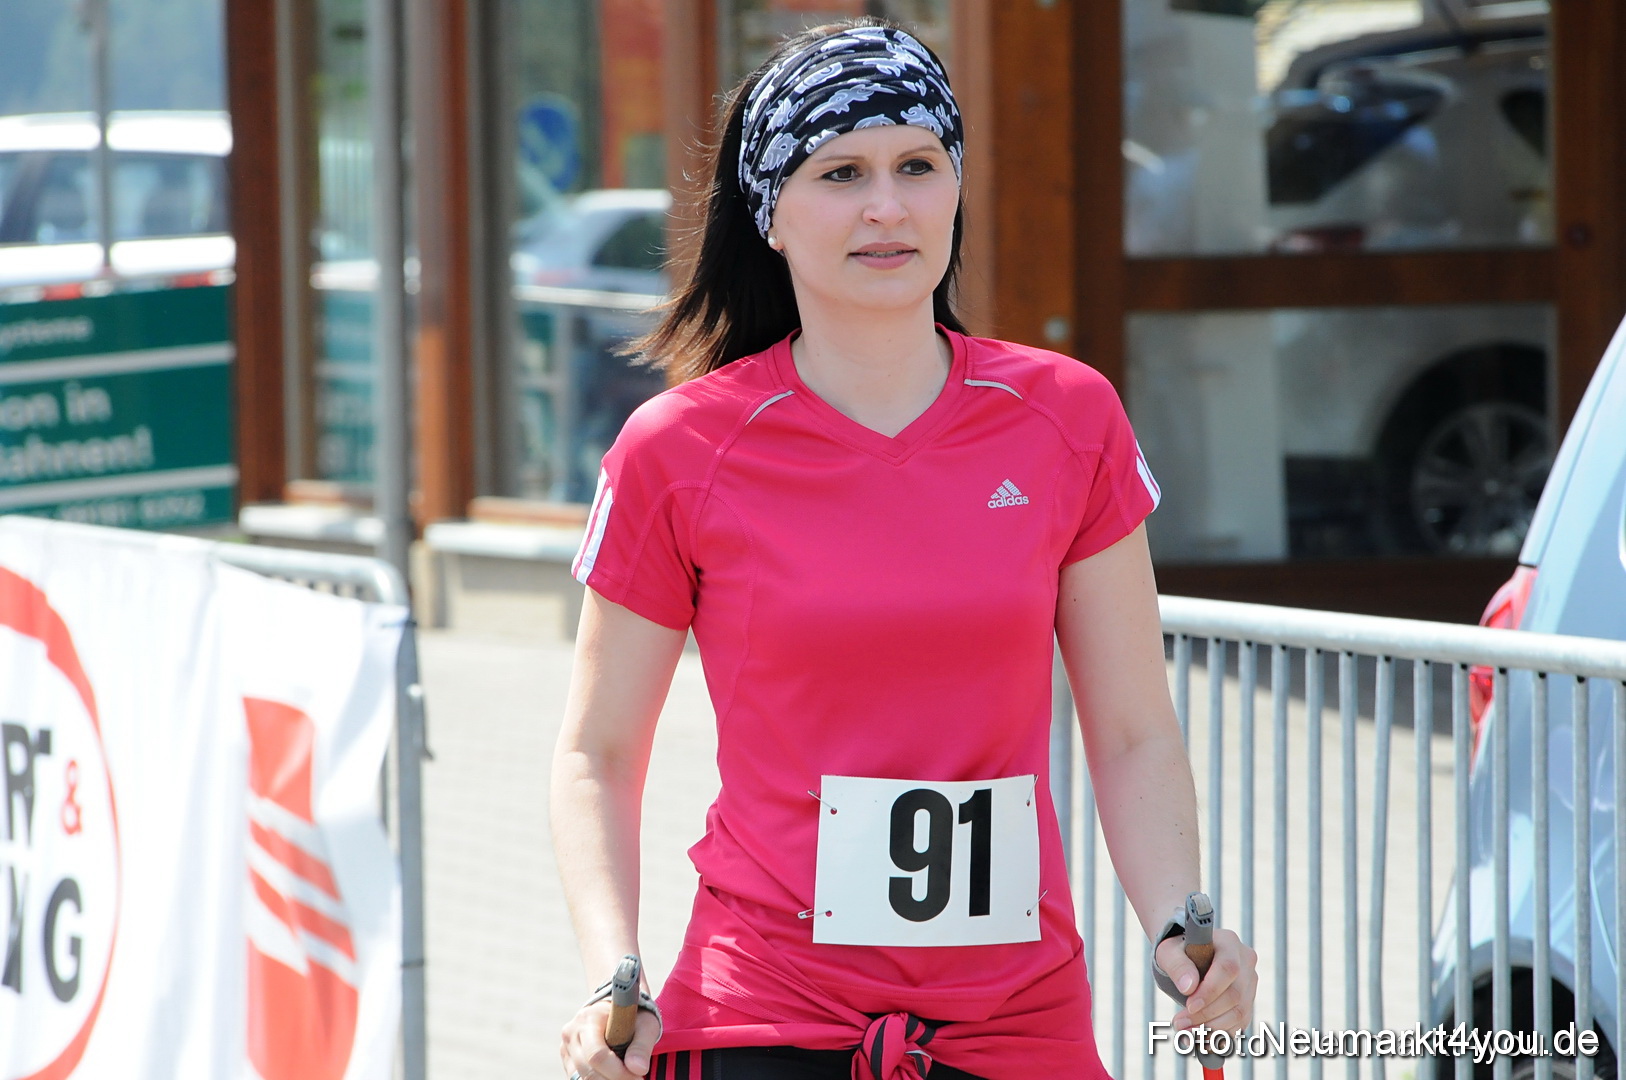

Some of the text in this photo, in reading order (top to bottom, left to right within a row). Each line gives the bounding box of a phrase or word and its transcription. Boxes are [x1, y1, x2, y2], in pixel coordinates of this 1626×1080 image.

[0, 380, 112, 431] on in
[987, 495, 1029, 509] adidas
[60, 758, 82, 835] &
[889, 787, 992, 923] 91
